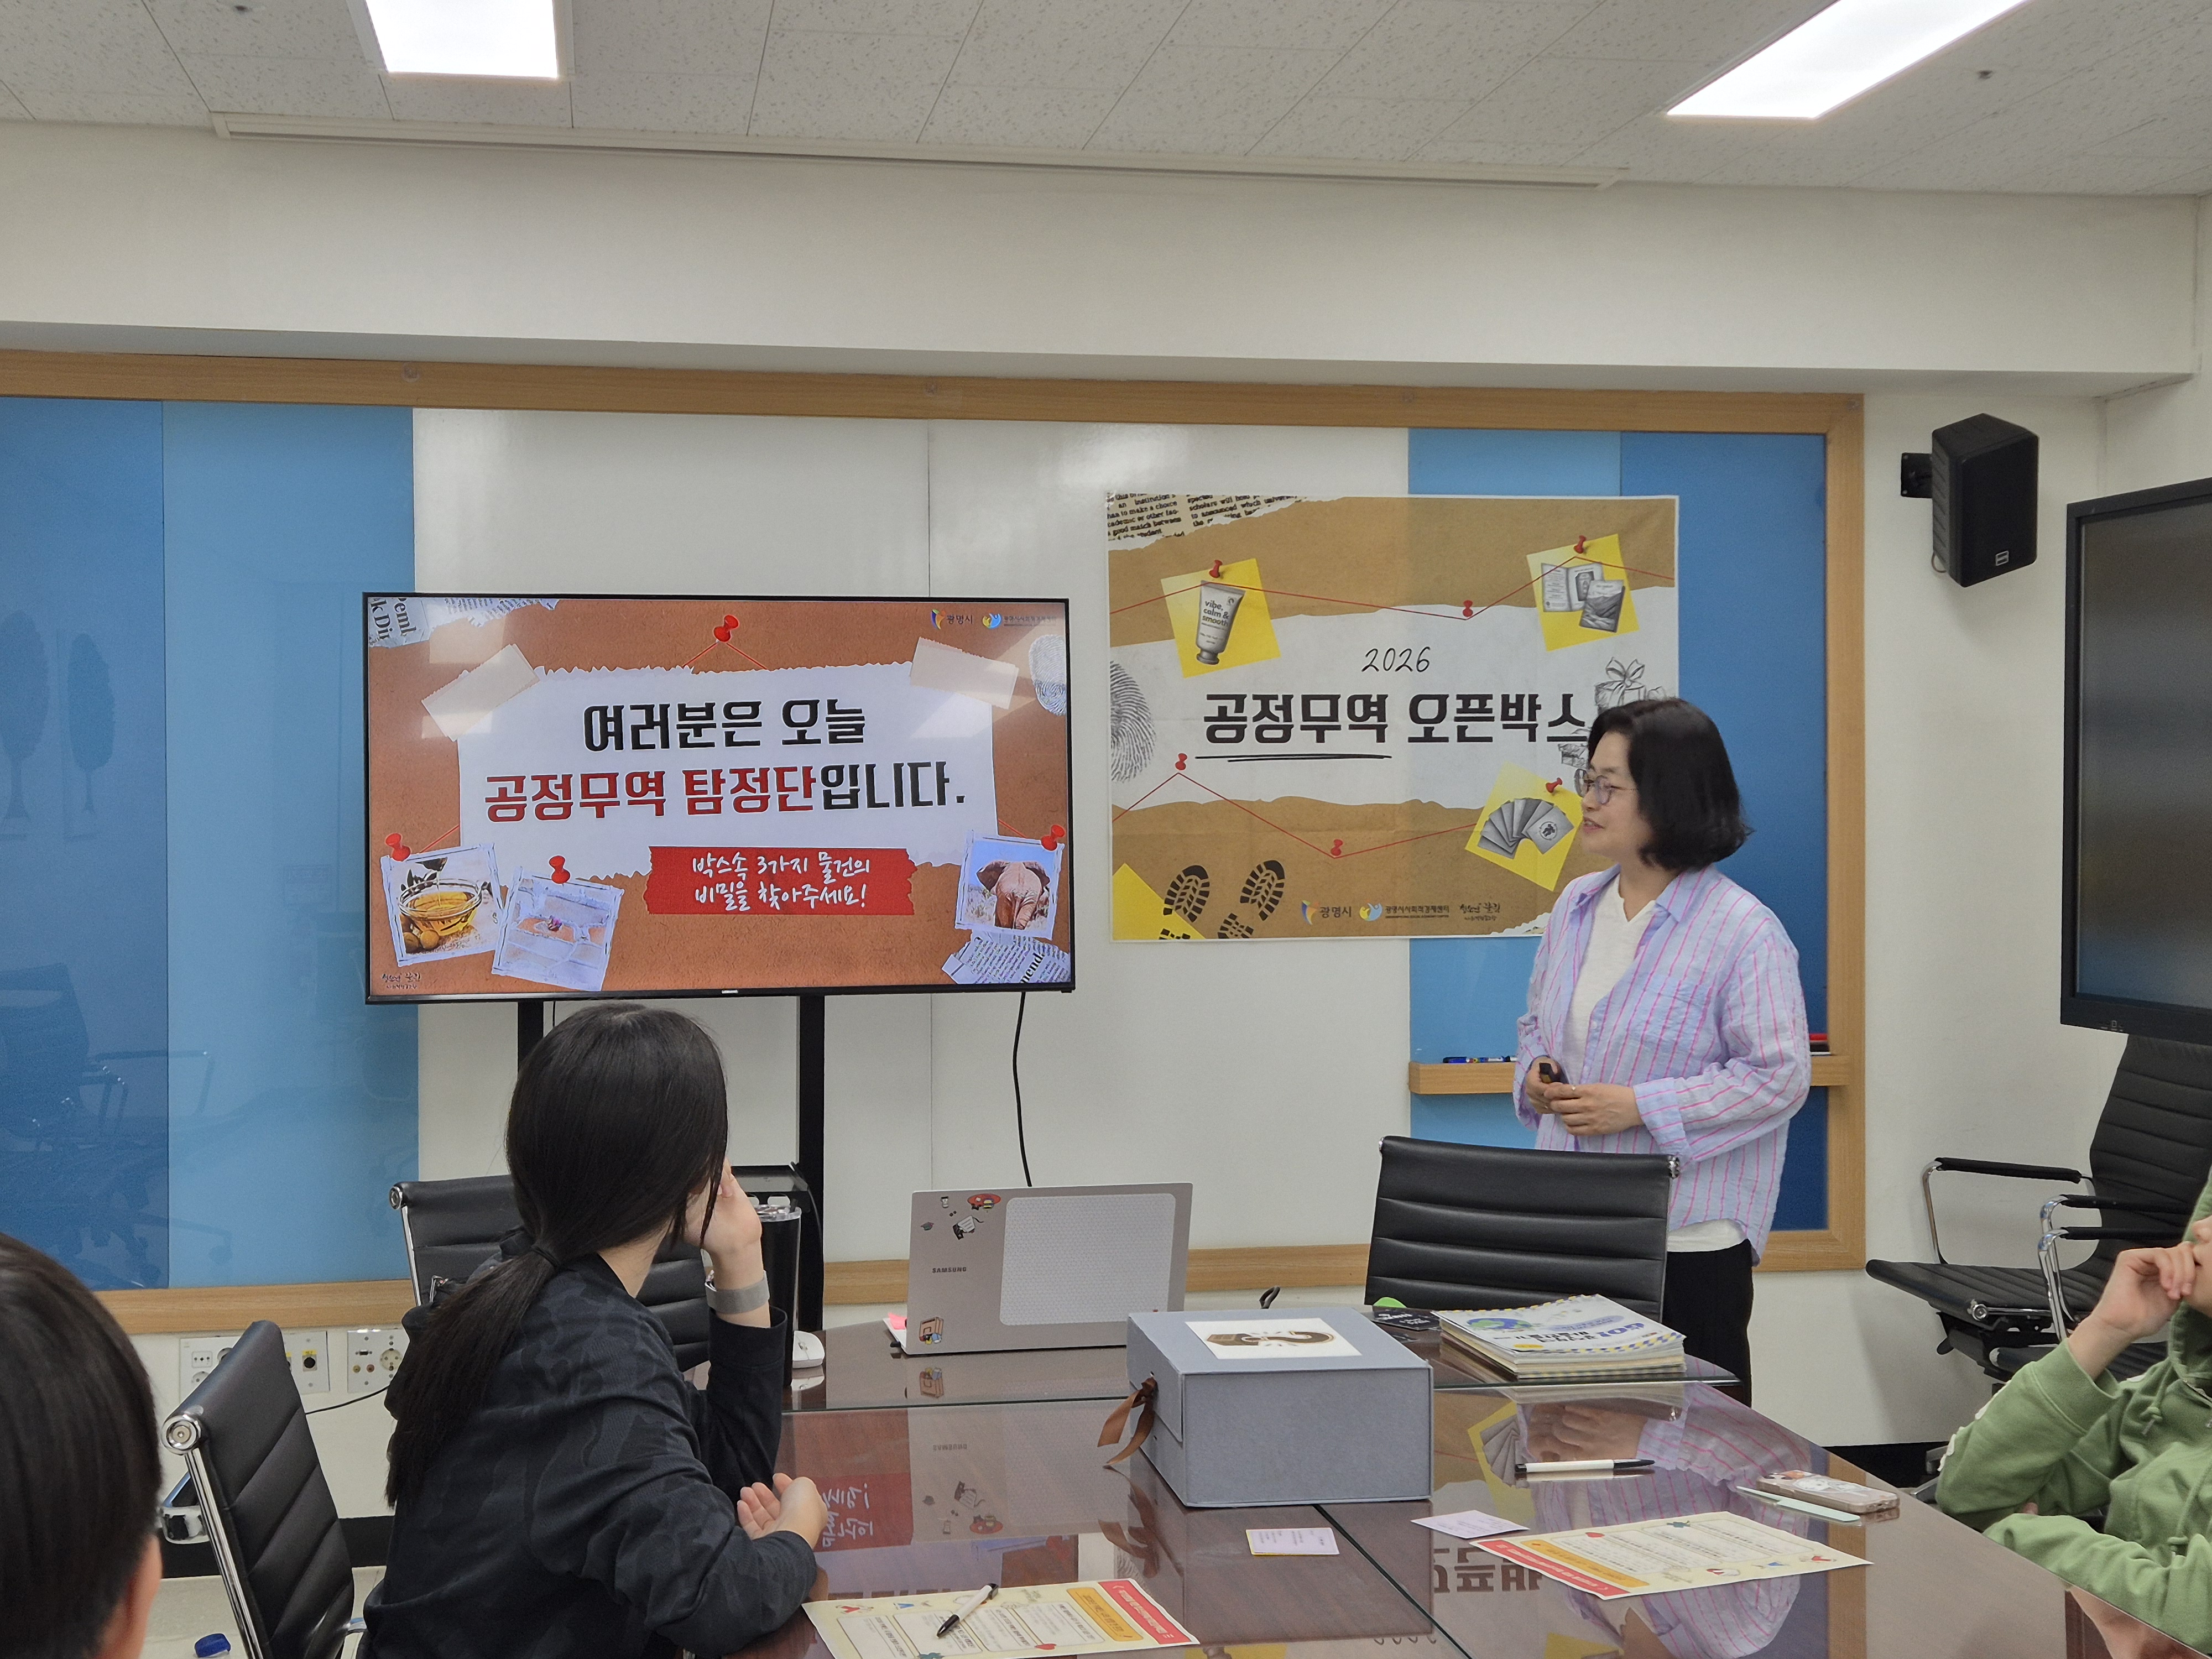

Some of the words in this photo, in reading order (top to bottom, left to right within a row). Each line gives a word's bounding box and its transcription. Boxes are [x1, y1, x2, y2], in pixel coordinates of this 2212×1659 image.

[1223, 611, 1229, 619] &
[1361, 646, 1431, 673] 2026
[583, 700, 763, 752] 여러분은
[781, 698, 865, 745] 오늘
[1203, 693, 1389, 744] 공정무역
[1408, 693, 1587, 743] 오픈박스
[484, 771, 667, 822] 공정무역
[682, 761, 966, 816] 탐정단입니다.
[692, 852, 748, 880] 박스속
[757, 855, 808, 874] 3가지
[818, 852, 870, 884] 물건의
[695, 880, 751, 911] 비밀을
[758, 881, 867, 910] 찾아주세요!
[1319, 906, 1352, 918] 광명시
